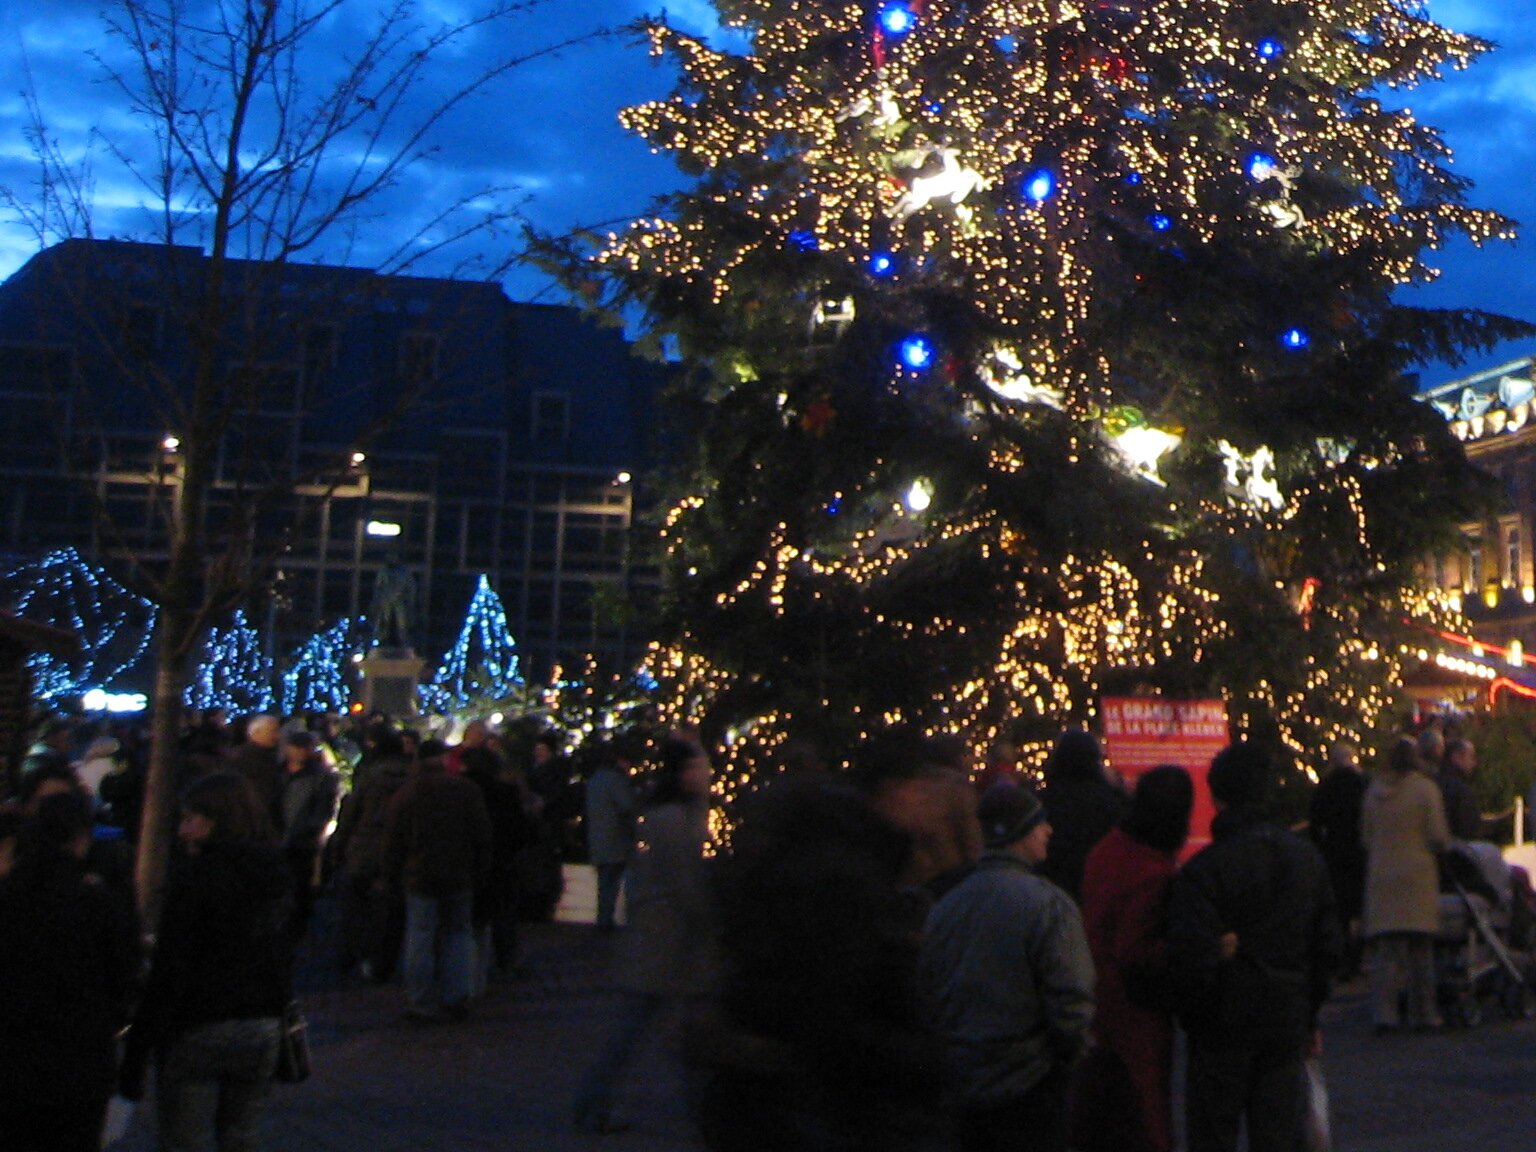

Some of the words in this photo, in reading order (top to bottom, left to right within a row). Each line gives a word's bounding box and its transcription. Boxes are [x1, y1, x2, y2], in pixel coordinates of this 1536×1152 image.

[1122, 703, 1173, 720] GRAND
[1177, 704, 1223, 721] SAPIN
[1143, 721, 1181, 736] PLACE
